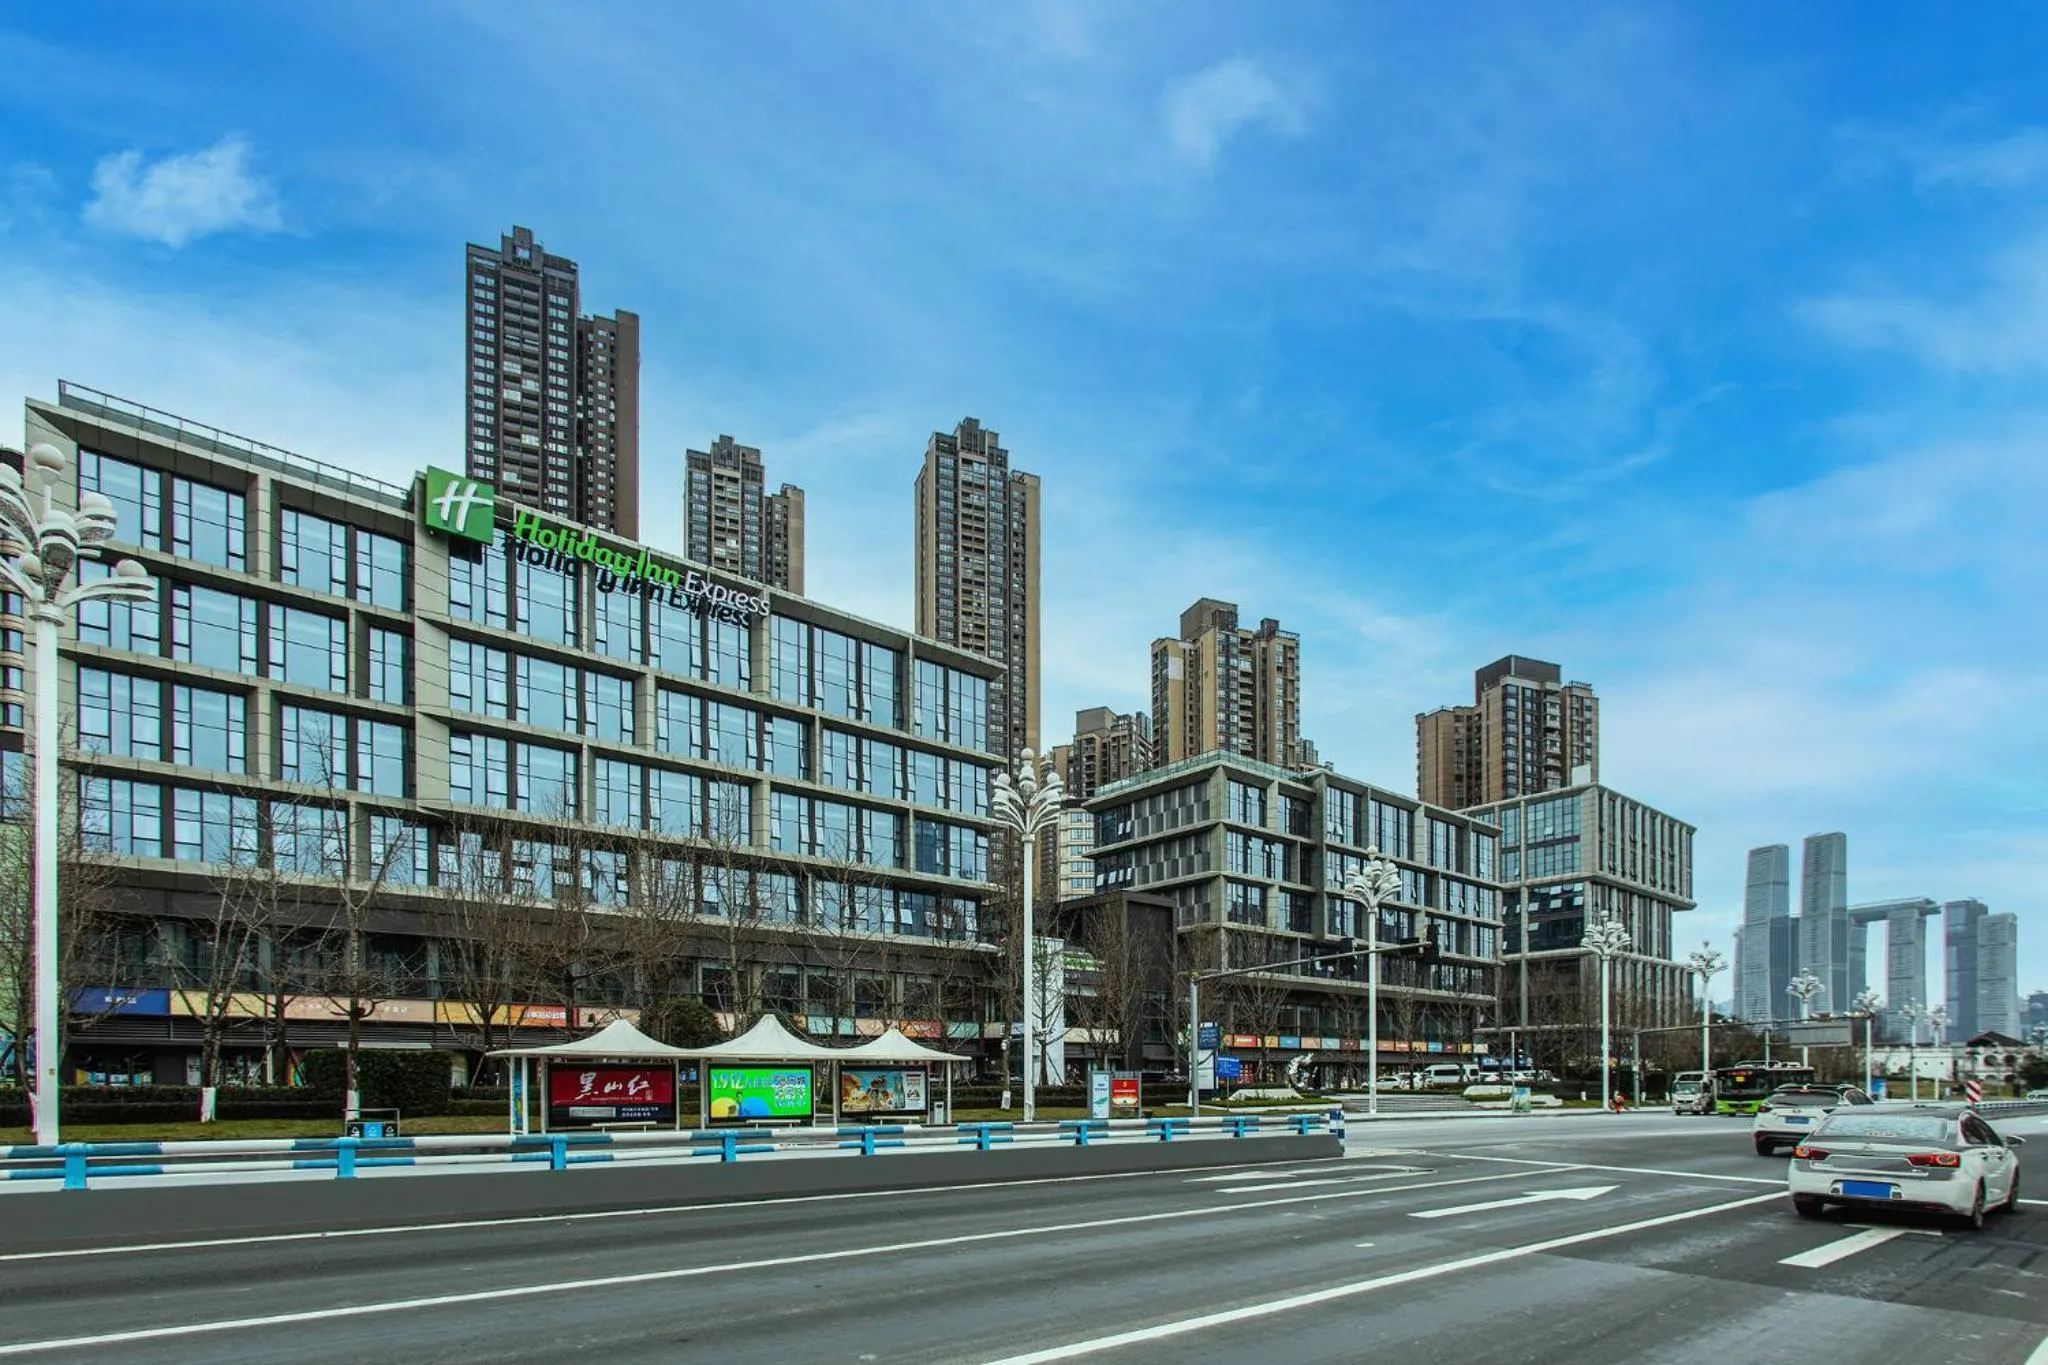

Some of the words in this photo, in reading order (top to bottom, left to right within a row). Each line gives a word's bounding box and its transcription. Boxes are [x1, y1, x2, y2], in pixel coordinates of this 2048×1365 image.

[514, 510, 635, 578] Holiday
[635, 550, 681, 588] Inn
[684, 571, 771, 618] Express
